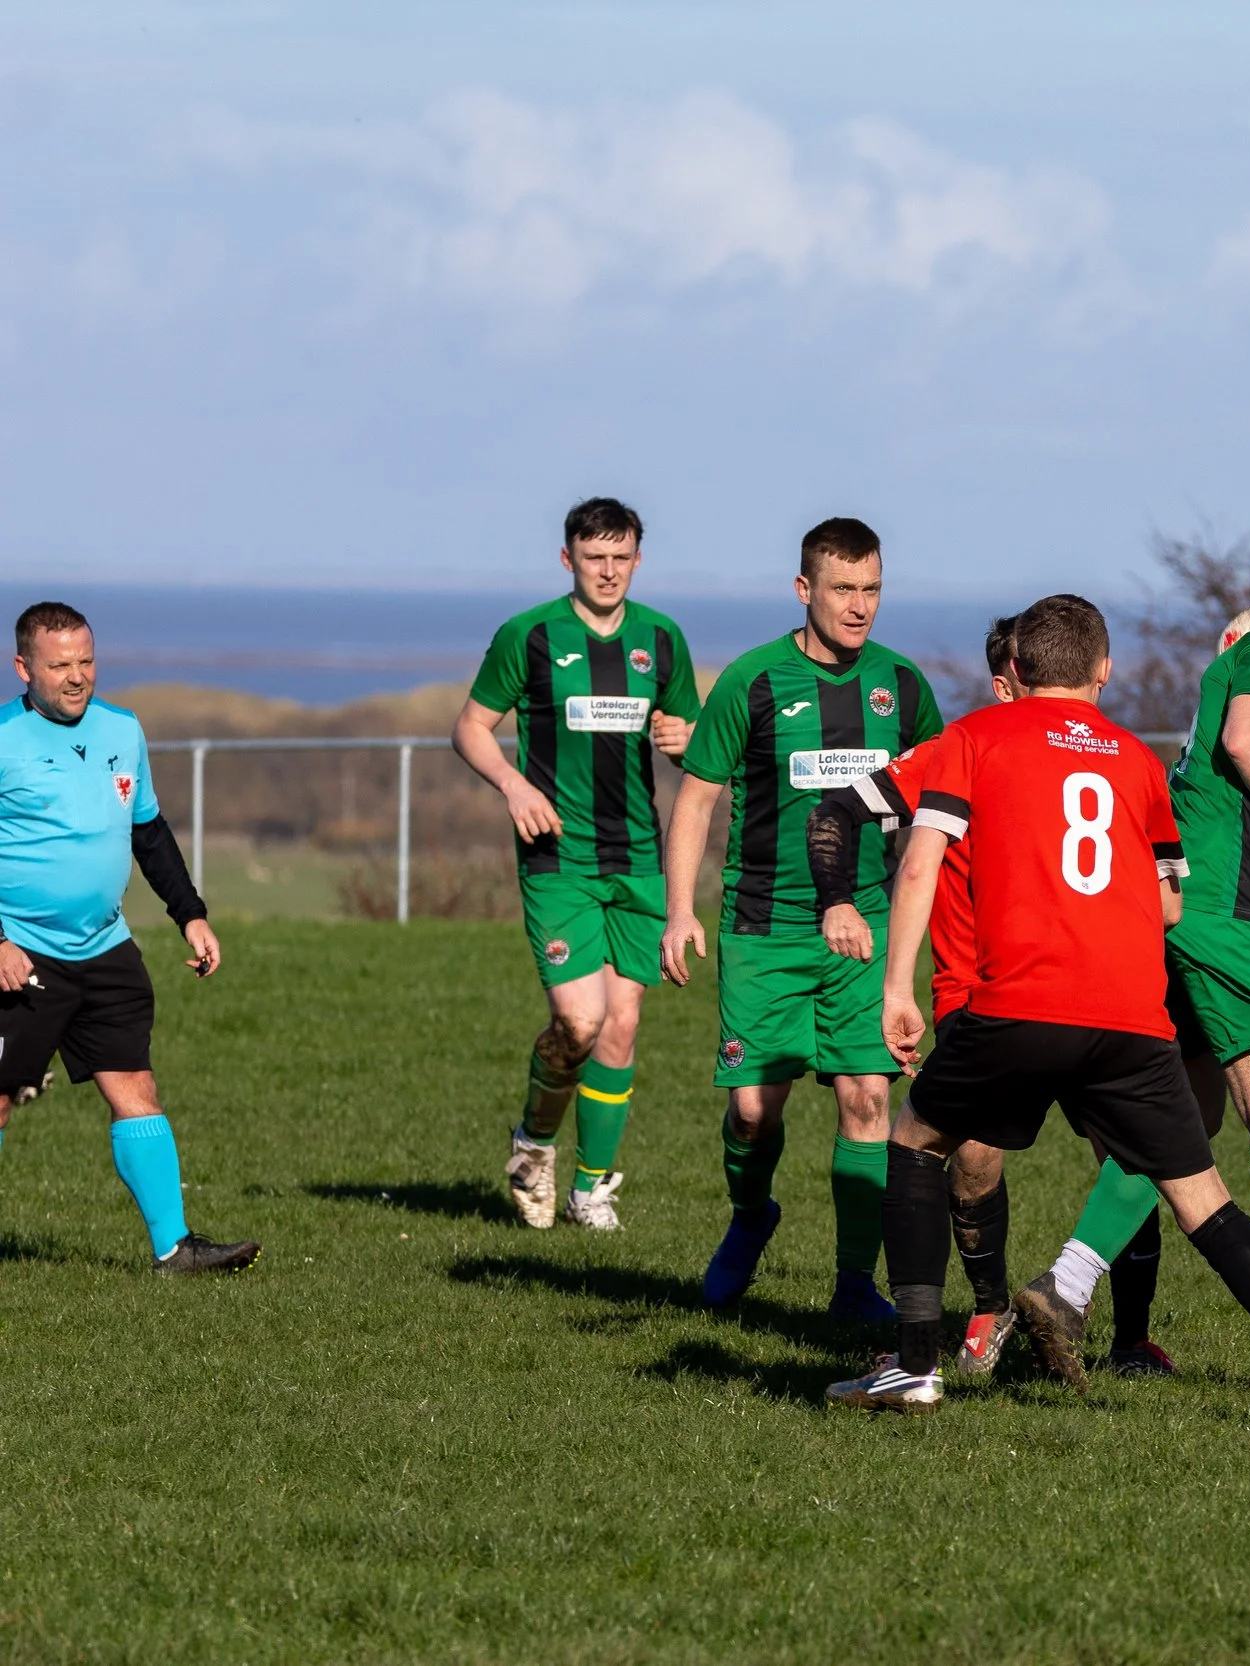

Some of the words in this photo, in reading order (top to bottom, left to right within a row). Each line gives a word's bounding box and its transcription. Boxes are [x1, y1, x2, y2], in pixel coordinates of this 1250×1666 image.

[590, 700, 639, 710] Lakeland
[1046, 731, 1063, 741] RG
[1065, 734, 1119, 748] HOWELLS
[1048, 739, 1083, 753] cleaning
[1084, 744, 1120, 756] services
[818, 753, 876, 764] Lakeland
[819, 765, 882, 775] Verandah
[1061, 772, 1114, 896] 8
